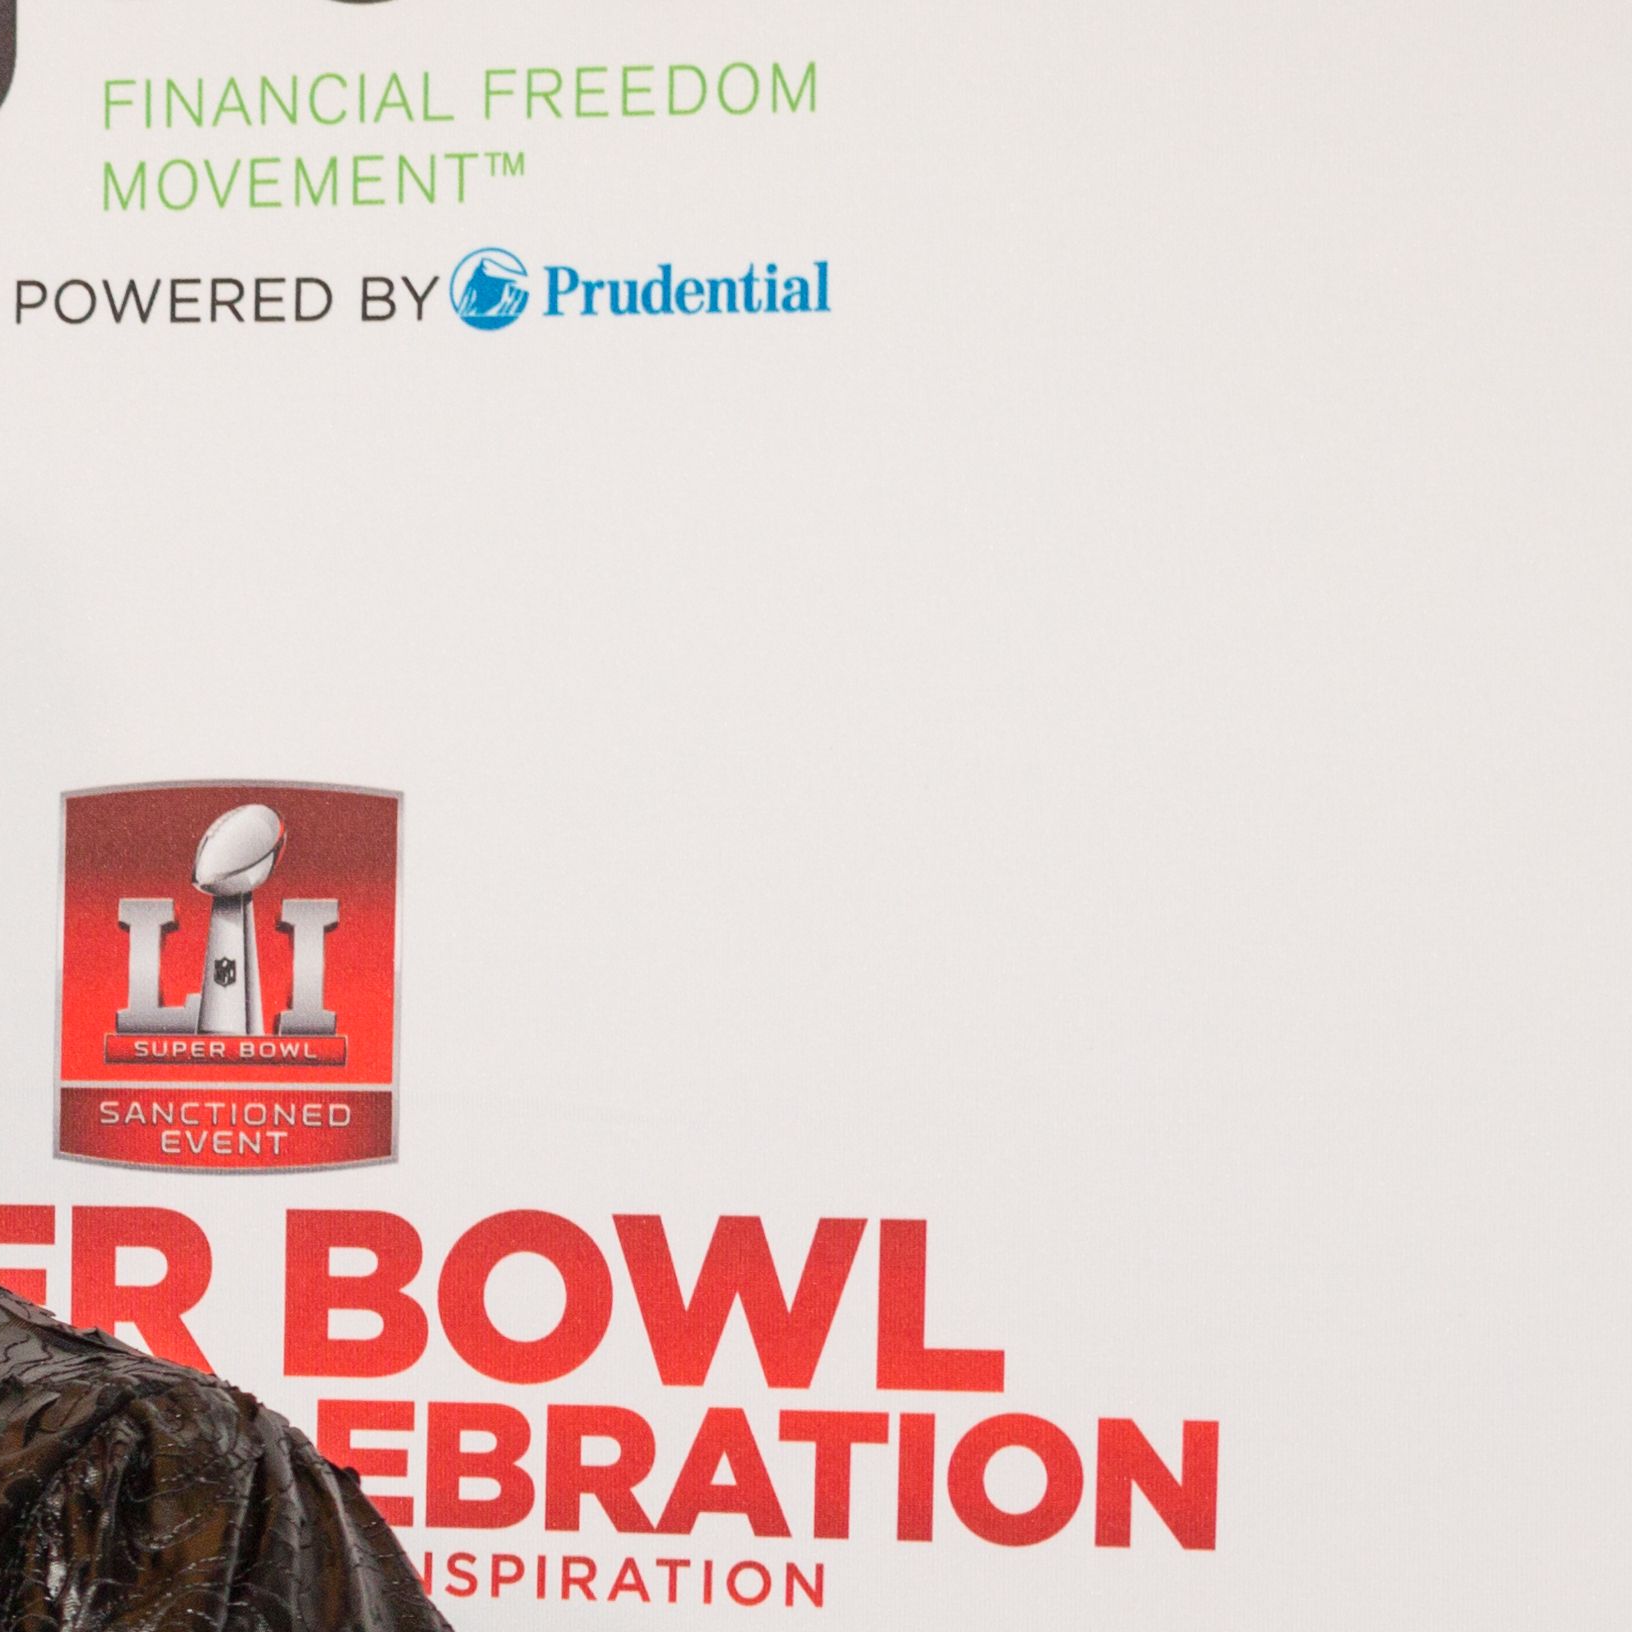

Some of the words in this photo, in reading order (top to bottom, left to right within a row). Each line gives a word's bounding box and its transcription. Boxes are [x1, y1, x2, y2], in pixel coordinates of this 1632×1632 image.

[104, 71, 455, 129] FINANCIAL
[484, 61, 816, 120] FREEDOM
[16, 277, 332, 324] POWERED
[361, 276, 439, 321] BY
[544, 261, 830, 316] Prudential
[133, 1040, 225, 1060] SUPER
[239, 1041, 318, 1060] BOWL
[99, 1100, 352, 1128] SANCTIONED
[159, 1129, 289, 1156] EVENT
[283, 1209, 1005, 1393] BOWL
